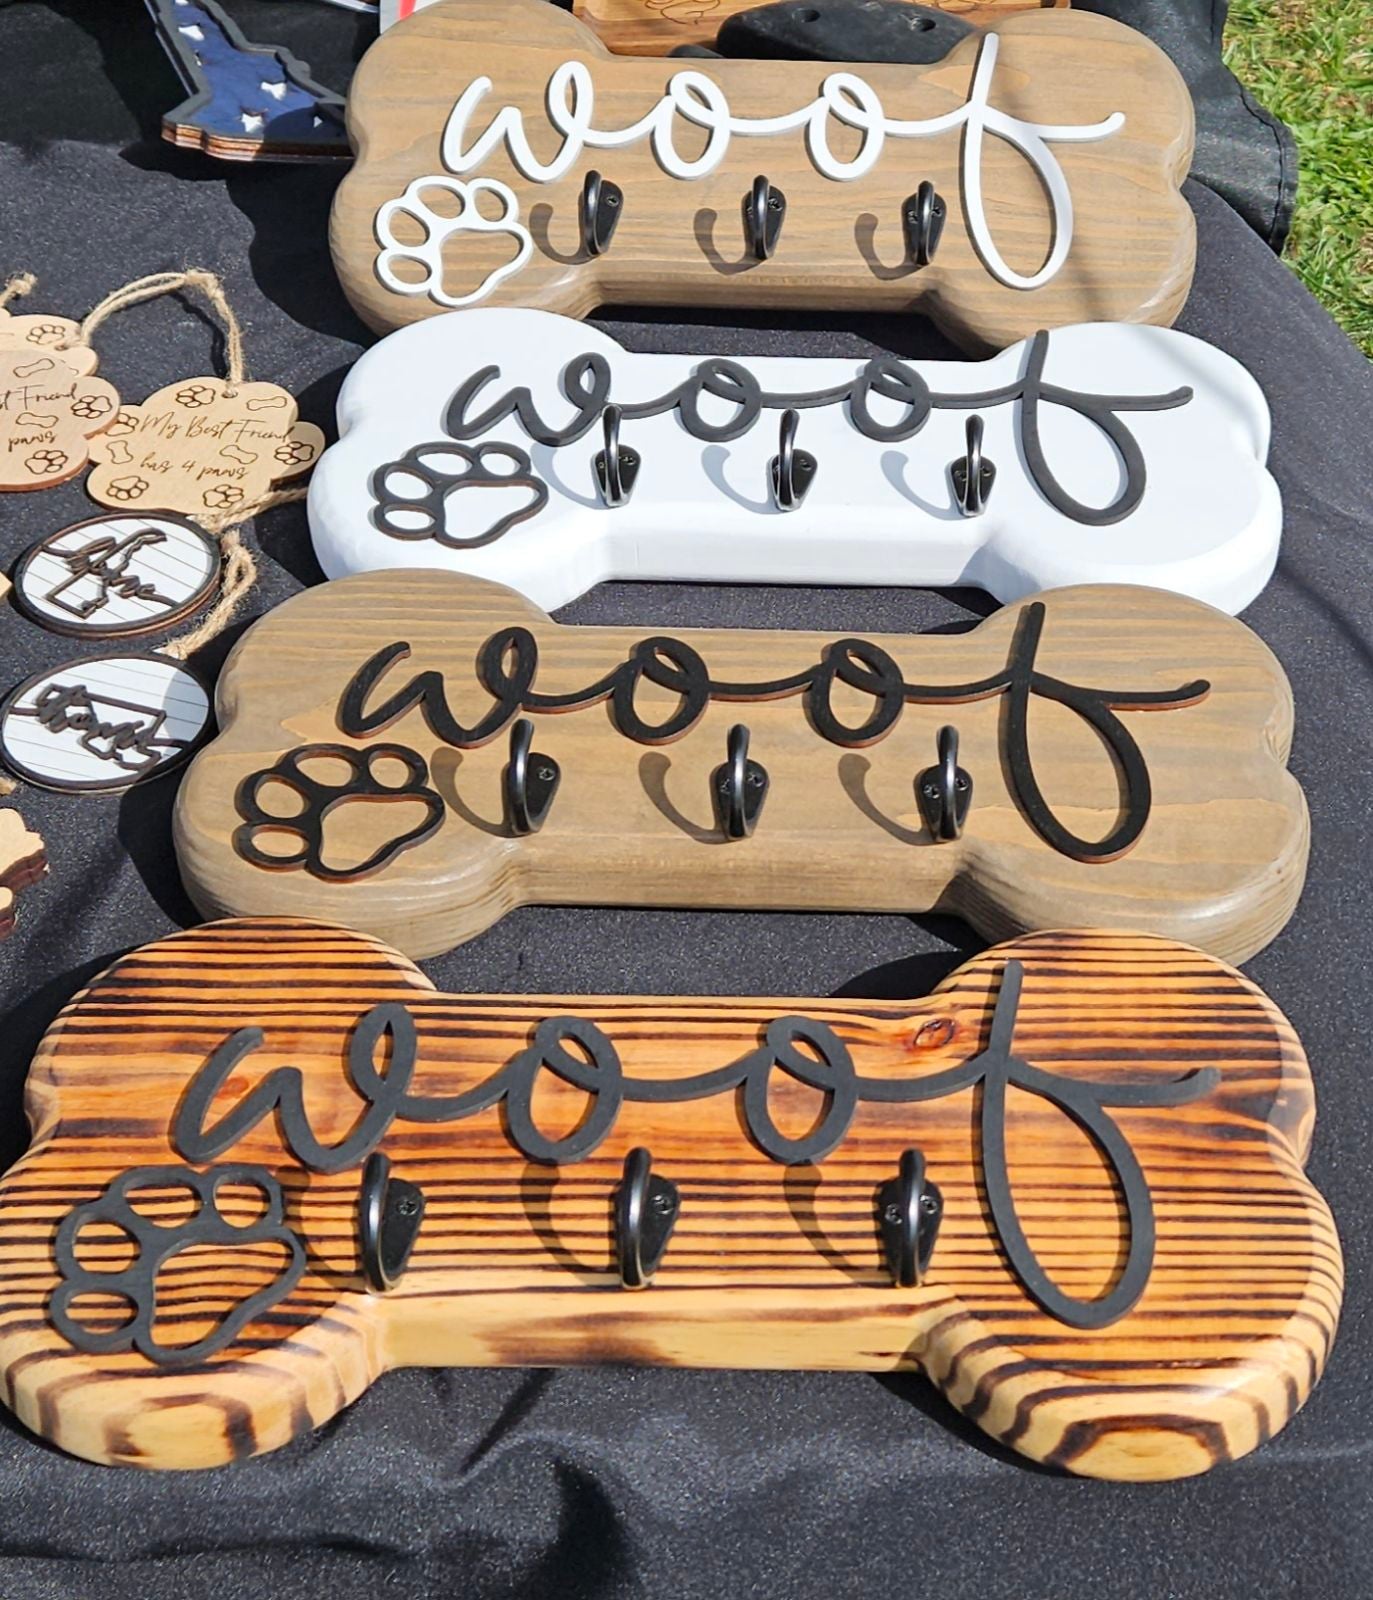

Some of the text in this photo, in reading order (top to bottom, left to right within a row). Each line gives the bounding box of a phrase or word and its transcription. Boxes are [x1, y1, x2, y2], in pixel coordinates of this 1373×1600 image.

[441, 32, 1127, 290] woof
[8, 430, 57, 452] paws
[17, 382, 78, 410] Friend
[140, 411, 295, 443] My Best Friend
[441, 329, 1194, 526] woof
[140, 451, 250, 481] has 4 paws
[336, 601, 1212, 865] woof
[169, 959, 1221, 1332] woof
